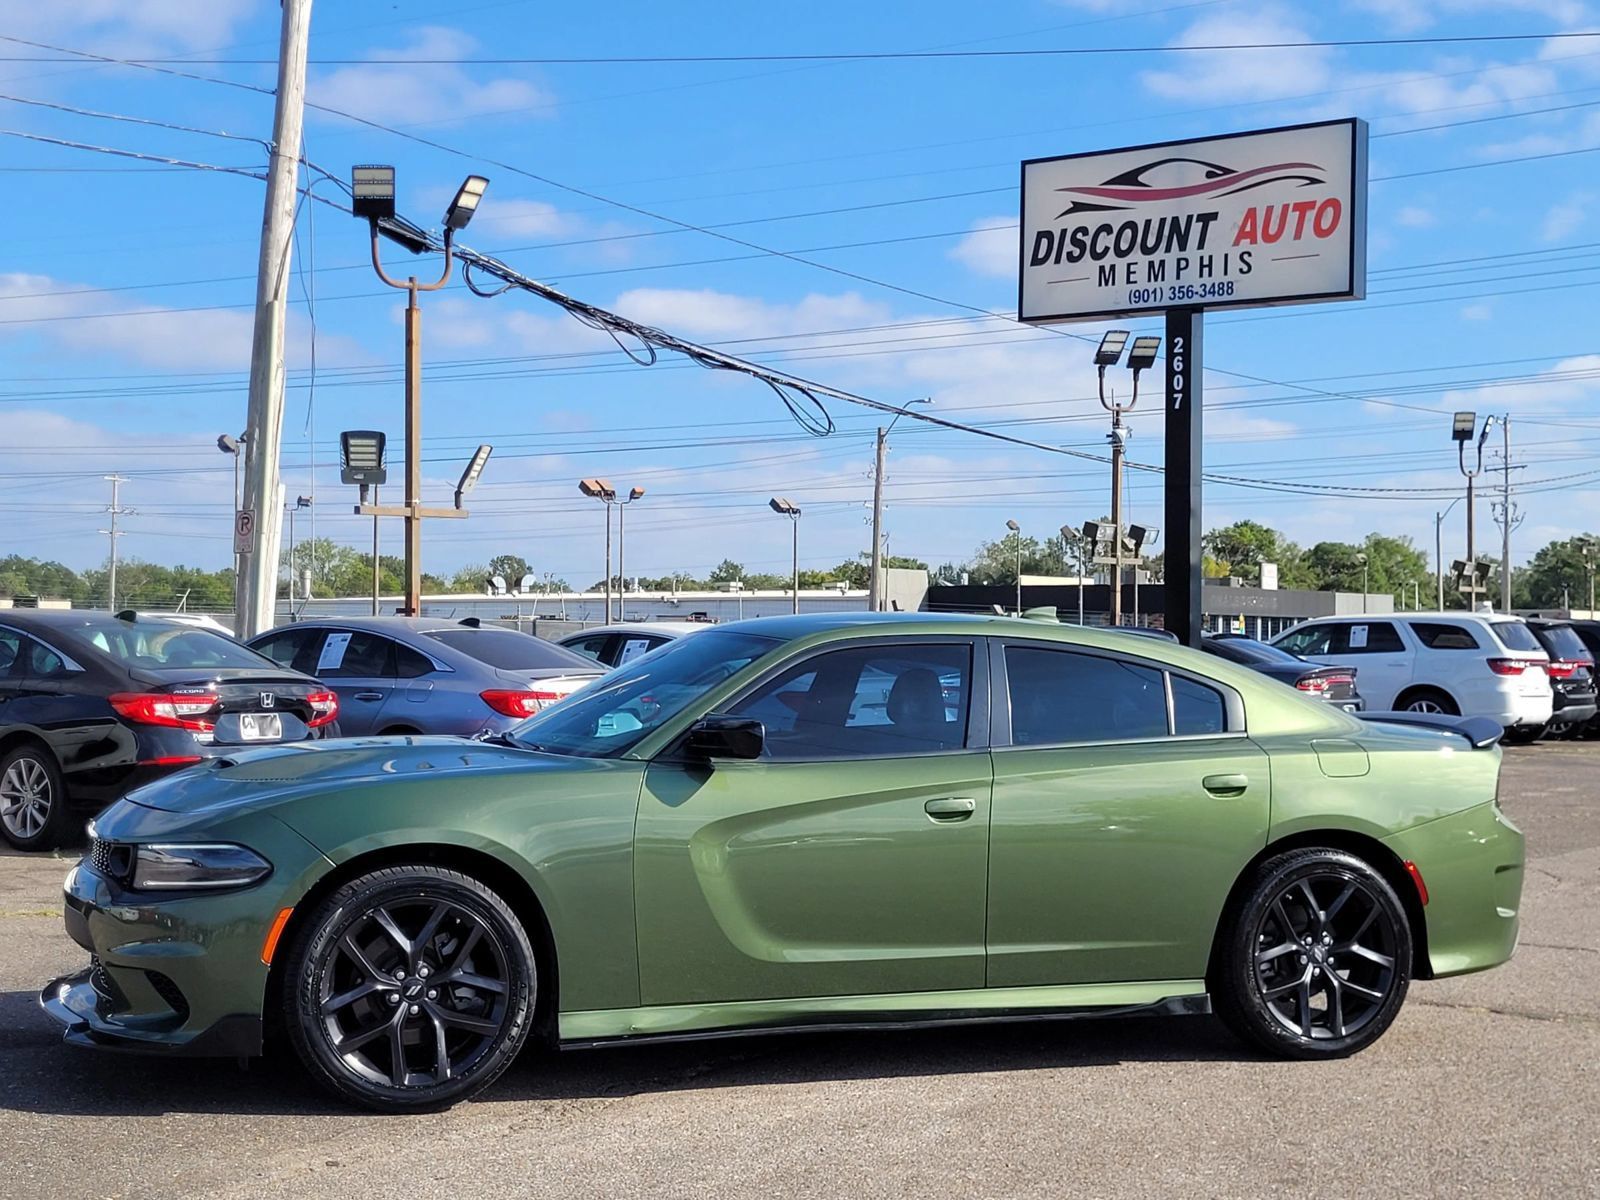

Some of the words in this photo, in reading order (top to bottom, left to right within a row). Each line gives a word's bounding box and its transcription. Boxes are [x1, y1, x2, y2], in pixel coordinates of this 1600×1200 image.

[1030, 211, 1219, 267] DISCOUNT
[1232, 197, 1342, 247] AUTO
[1098, 251, 1253, 287] MEMPHIS
[1128, 287, 1164, 304] (901)
[1168, 281, 1234, 302] 356-3488
[1172, 336, 1184, 409] 2607
[507, 983, 528, 1042] ATLAS
